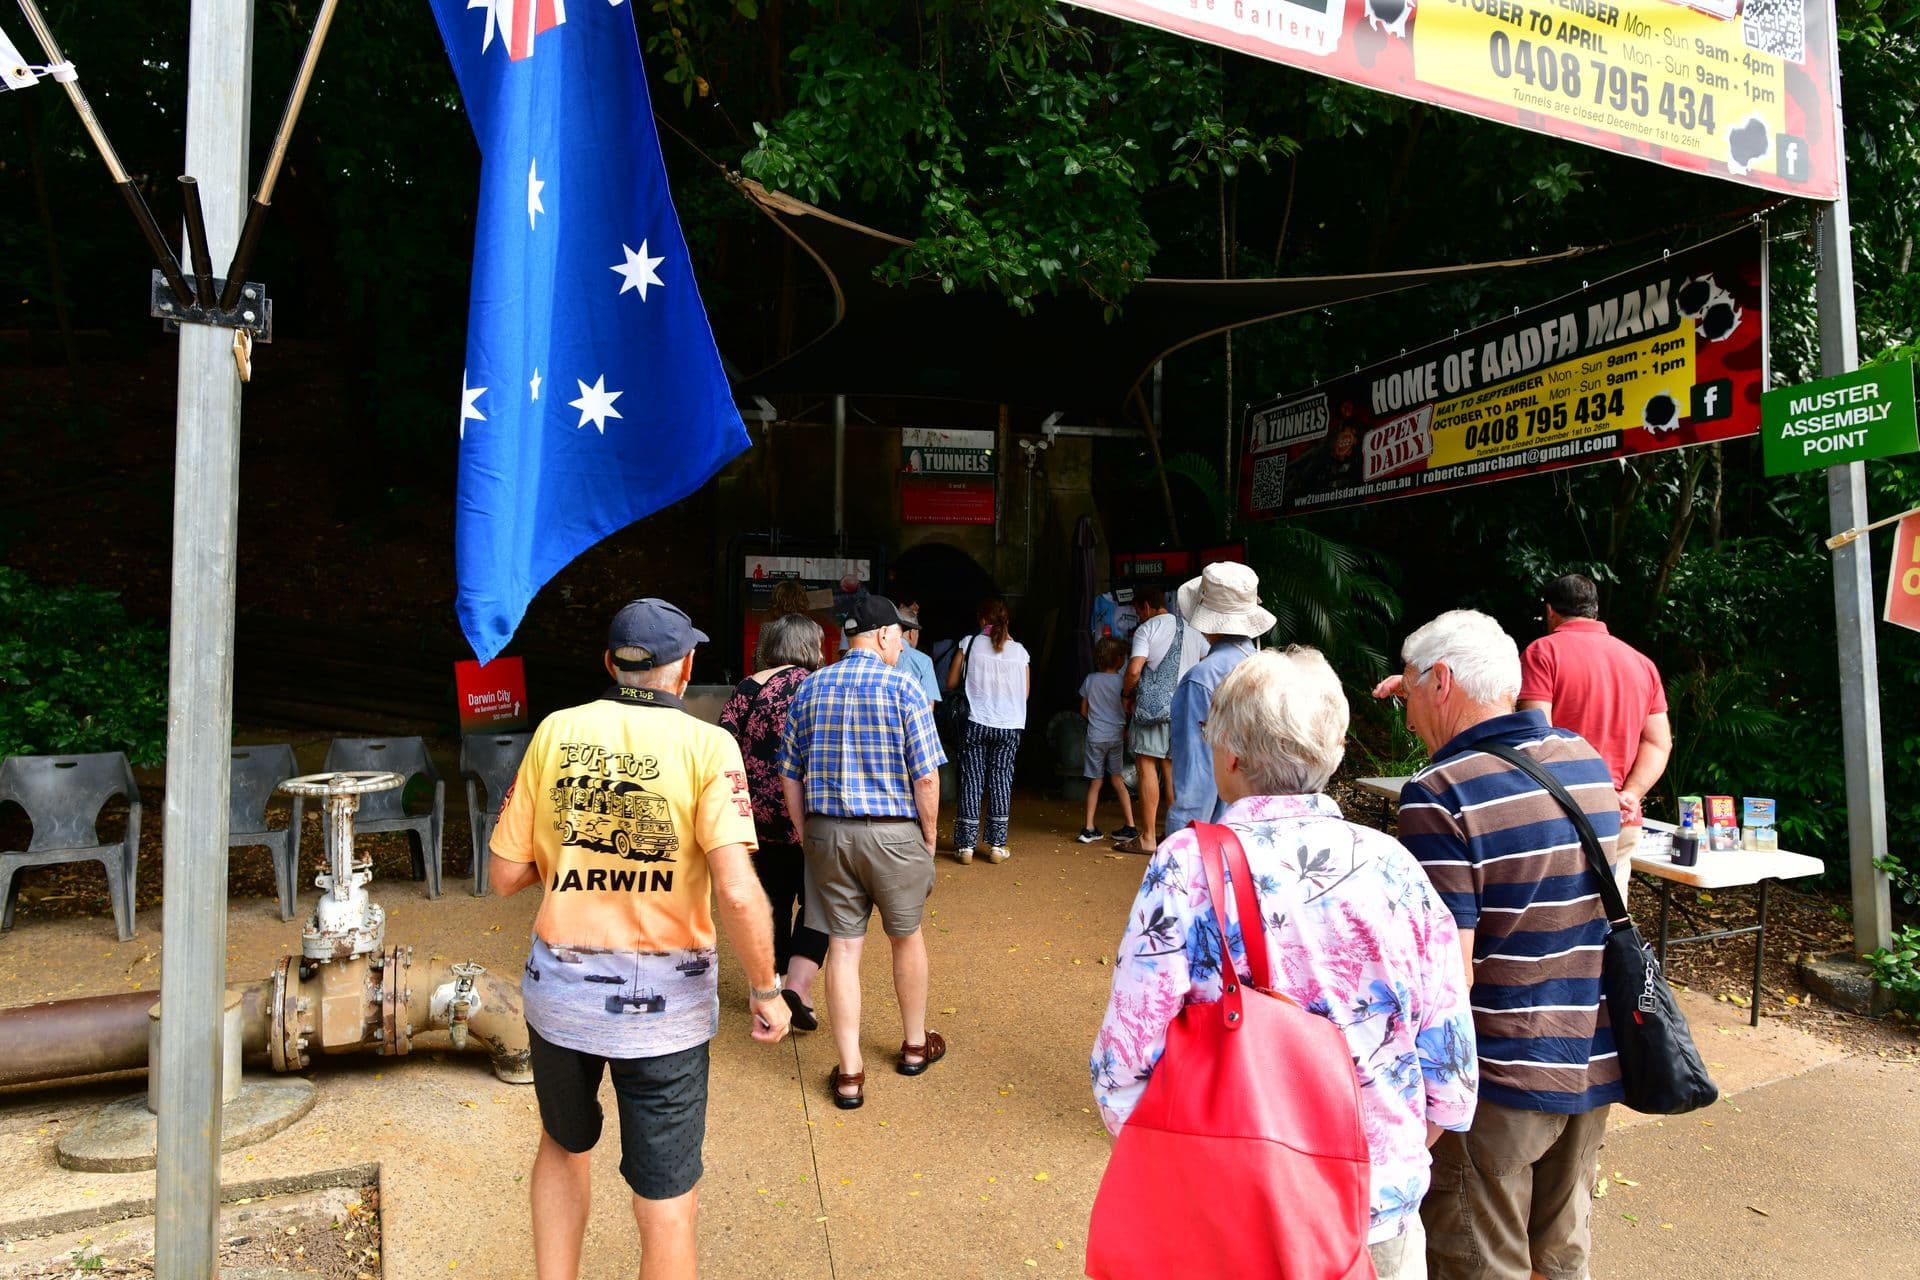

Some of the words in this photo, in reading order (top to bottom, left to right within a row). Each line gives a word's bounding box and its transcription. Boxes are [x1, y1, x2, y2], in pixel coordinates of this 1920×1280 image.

[1234, 0, 1325, 46] Gallery
[1624, 12, 1651, 39] Mon
[1663, 27, 1689, 50] Sun
[1695, 38, 1730, 64] 9am
[1742, 53, 1775, 78] 4pm
[1529, 9, 1553, 37] TO
[1556, 21, 1608, 55] APRIL
[1623, 43, 1653, 67] Mon
[1664, 56, 1690, 79] Sun
[1696, 65, 1730, 91] 9am
[1743, 80, 1775, 103] 1pm
[1489, 30, 1582, 98] 0408
[1590, 60, 1649, 117] 795
[1658, 81, 1716, 135] 434
[1513, 88, 1553, 109] Tunnels
[1554, 102, 1570, 114] are
[1573, 105, 1605, 123] closed
[1607, 113, 1653, 136] December
[1655, 127, 1669, 141] 1st
[1671, 132, 1680, 143] to
[1371, 361, 1439, 416] HOME
[1442, 349, 1475, 393] OF
[1481, 312, 1579, 384] AADFA
[1585, 278, 1672, 348] MAN
[1433, 409, 1483, 432] OCTOBER
[1485, 402, 1502, 417] TO
[1505, 394, 1539, 414] APRIL
[1549, 386, 1571, 401] Mon
[1580, 377, 1602, 393] Sun
[1606, 368, 1638, 387] 9am
[1652, 356, 1686, 376] 1pm
[1436, 402, 1458, 417] MAY
[1460, 398, 1474, 410] TO
[1476, 376, 1544, 405] SEPTEMBER
[1547, 369, 1572, 385] Mon
[1581, 360, 1603, 376] Sun
[1607, 350, 1638, 368] 9am
[1651, 336, 1686, 357] 4pm
[1789, 382, 1879, 417] MUSTER
[1269, 406, 1327, 442] TUNNELS
[1370, 413, 1422, 451] OPEN
[1465, 413, 1519, 450] 0408
[1525, 402, 1568, 437] 795
[1574, 387, 1625, 425] 434
[1535, 430, 1570, 444] December
[1781, 401, 1892, 440] ASSEMBLY
[923, 453, 990, 472] TUNNELS
[1370, 432, 1425, 476] DAILY
[1422, 434, 1617, 485] robertc.marchant@gmail.com
[1803, 429, 1868, 457] POINT
[468, 691, 496, 706] Darwin
[496, 689, 511, 703] City
